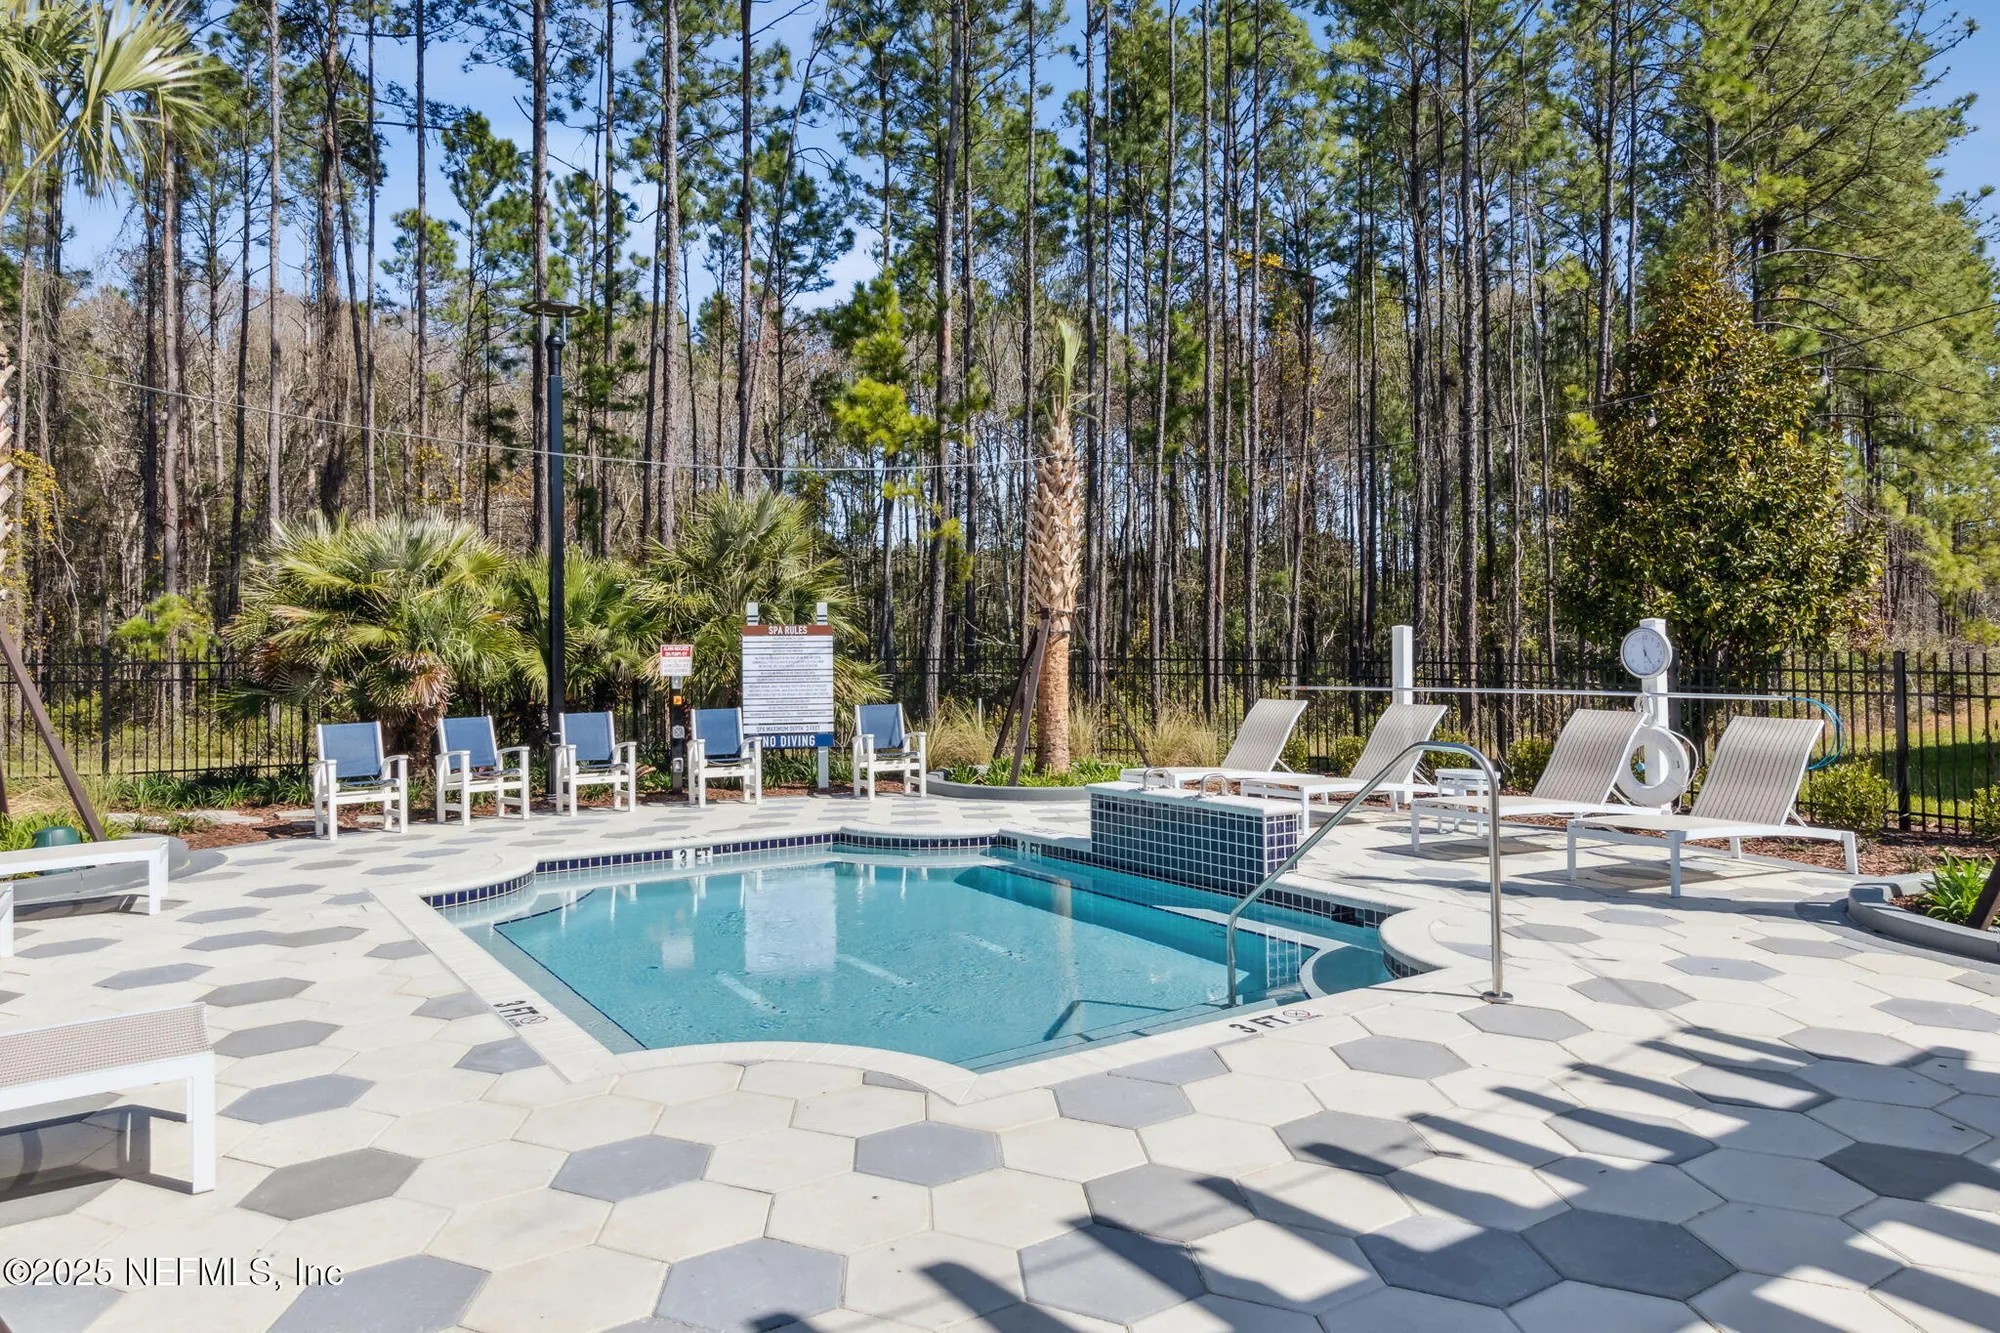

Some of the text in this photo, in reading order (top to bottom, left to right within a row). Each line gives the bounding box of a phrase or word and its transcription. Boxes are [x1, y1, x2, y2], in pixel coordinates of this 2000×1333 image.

[768, 625, 808, 635] SPA RULES
[762, 735, 816, 748] NO DIVING
[499, 1006, 539, 1018] FT
[1229, 1023, 1257, 1033] 3
[1248, 1014, 1291, 1028] FT
